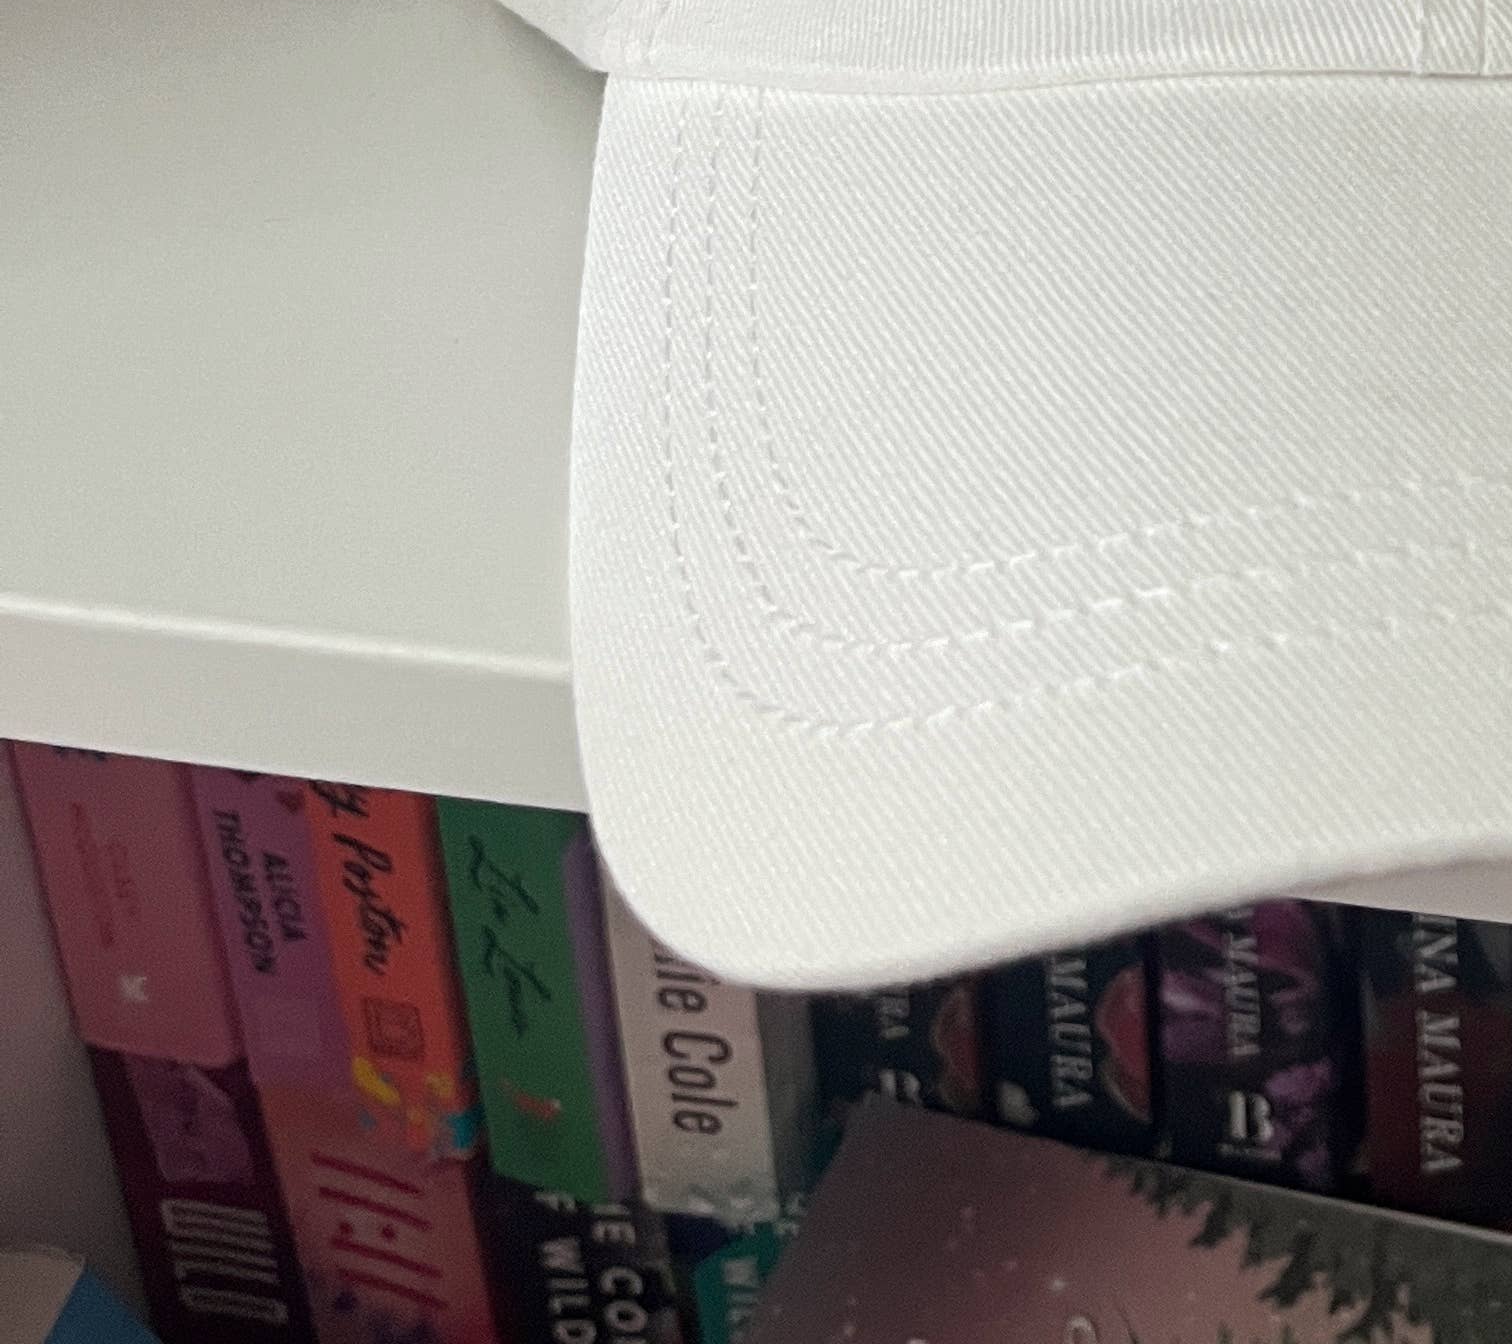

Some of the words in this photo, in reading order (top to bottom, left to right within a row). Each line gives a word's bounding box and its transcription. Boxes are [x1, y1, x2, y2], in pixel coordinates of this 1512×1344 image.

[216, 811, 276, 975] THOMPSON
[663, 1030, 739, 1138] Cole
[1050, 952, 1094, 1108] MAURA
[1417, 1010, 1464, 1176] MAURA
